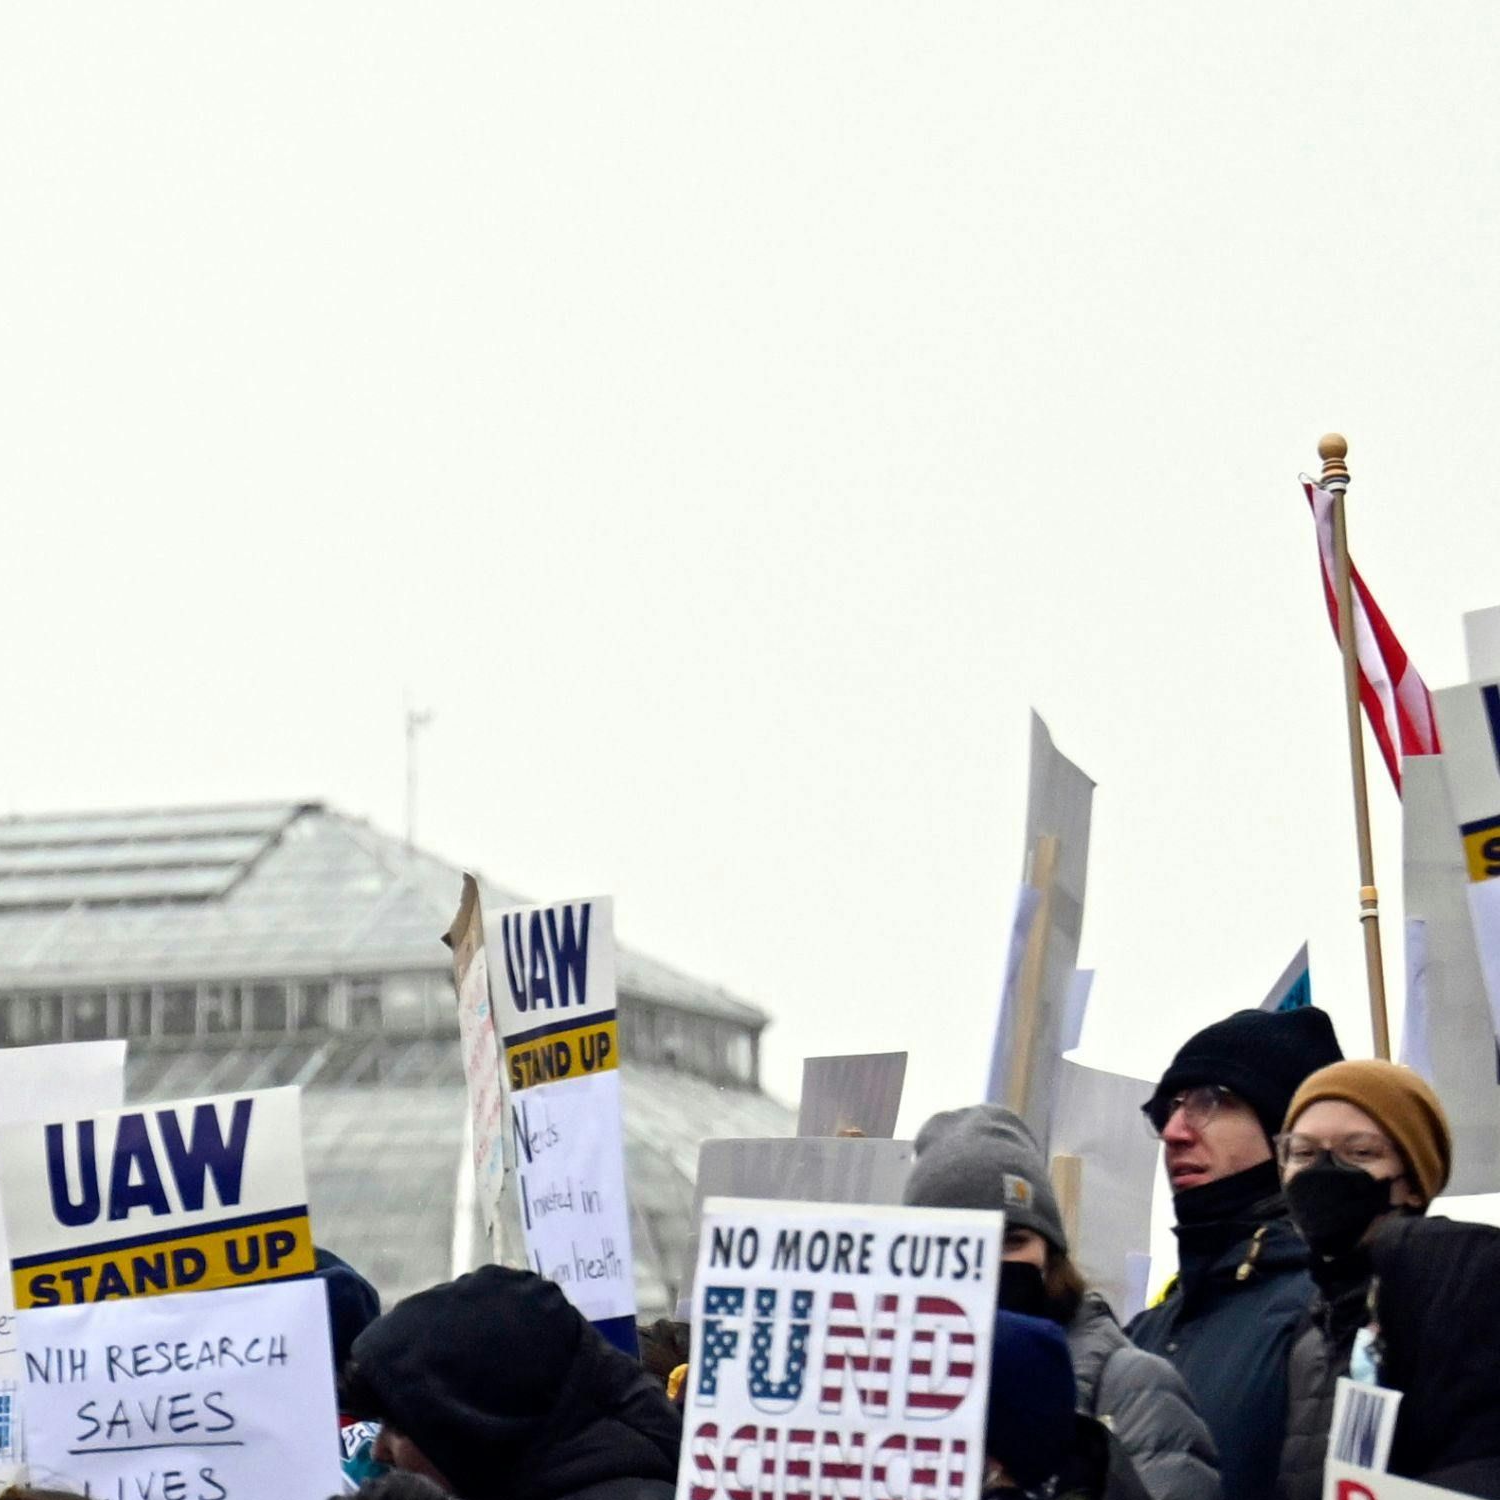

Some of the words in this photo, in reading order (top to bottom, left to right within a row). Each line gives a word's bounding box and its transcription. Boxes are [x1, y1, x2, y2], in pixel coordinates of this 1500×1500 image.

[501, 903, 591, 1013] UAW
[510, 1041, 571, 1090] STAND
[580, 1031, 610, 1072] UP
[44, 1098, 254, 1227] UAW
[29, 1247, 207, 1308] STAND
[224, 1230, 296, 1275] UP
[710, 1227, 759, 1269] NO
[771, 1229, 875, 1275] MORE
[888, 1234, 985, 1280] CUTS!
[25, 1347, 87, 1383] NIH
[106, 1335, 288, 1383] RESEARCH
[695, 1286, 976, 1421] FUND
[76, 1392, 235, 1441] SAVES
